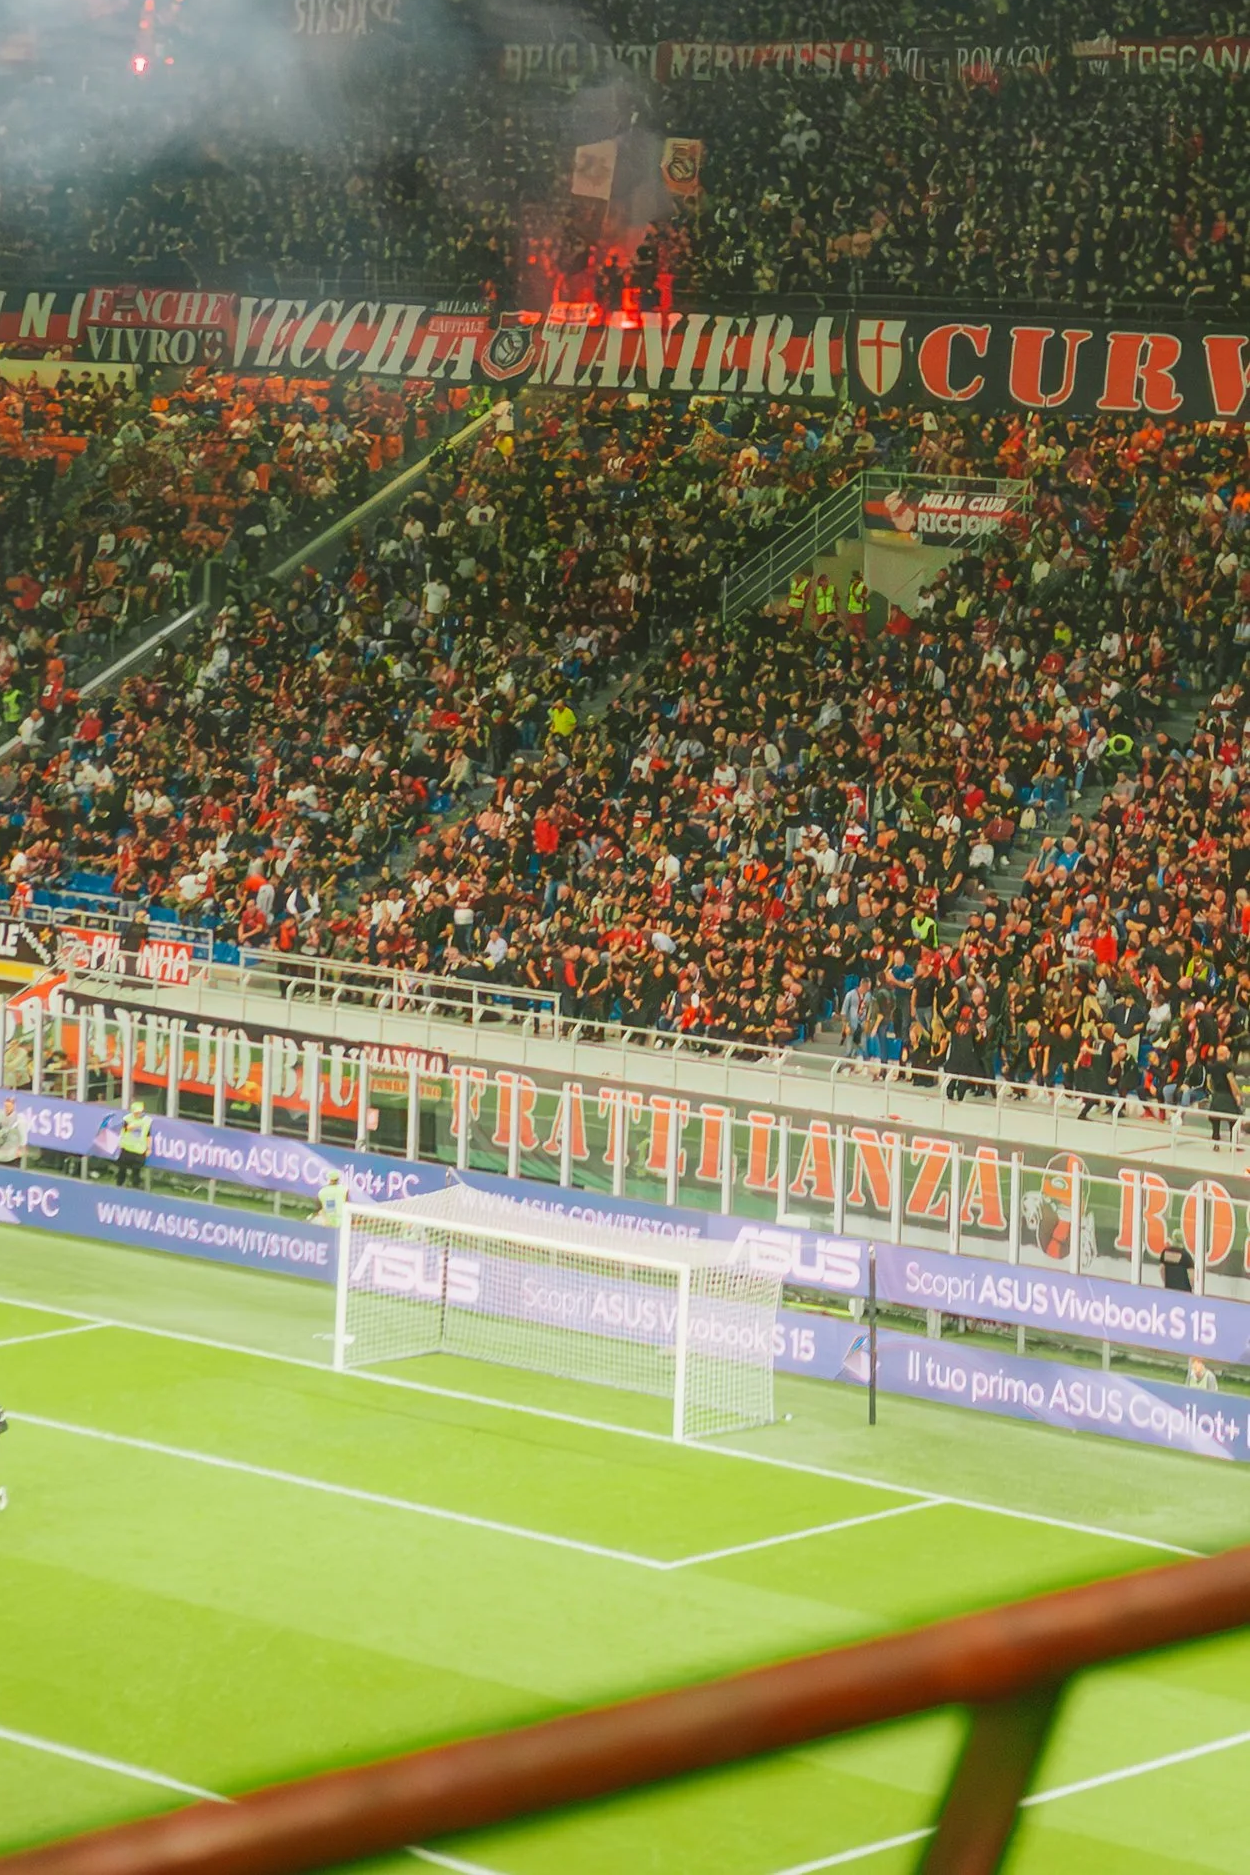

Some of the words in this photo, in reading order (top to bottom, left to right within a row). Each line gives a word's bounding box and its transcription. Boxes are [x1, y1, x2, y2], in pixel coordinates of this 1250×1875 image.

[233, 295, 479, 381] VECCHIA
[528, 307, 838, 398] MANIERA
[918, 493, 966, 511] MILAN
[968, 495, 1008, 513] CLUB
[90, 935, 191, 983] PIRNHA
[38, 1108, 53, 1138] S
[53, 1111, 75, 1140] 15
[154, 1130, 187, 1161] tuo
[188, 1137, 244, 1171] primo
[245, 1144, 301, 1182] ASUS
[385, 1169, 421, 1201] PC
[26, 1186, 61, 1218] PC
[97, 1201, 329, 1267] WWW.ASUS.COM/IT/STORE
[349, 1240, 482, 1305] ASUS
[726, 1225, 862, 1291] ASUS
[521, 1277, 589, 1323] Scopri
[590, 1290, 661, 1333] ASUS
[770, 1323, 787, 1358] S
[788, 1327, 815, 1363] 15
[904, 1260, 976, 1307] Scopri
[978, 1277, 1048, 1315] ASUS
[1050, 1286, 1167, 1337] Vivobook
[1168, 1305, 1187, 1342] S
[1190, 1310, 1217, 1347] 15
[925, 1357, 968, 1392] tuo
[970, 1368, 1045, 1409] primo
[1048, 1378, 1124, 1425] ASUS
[1128, 1392, 1241, 1442] Copilot+
